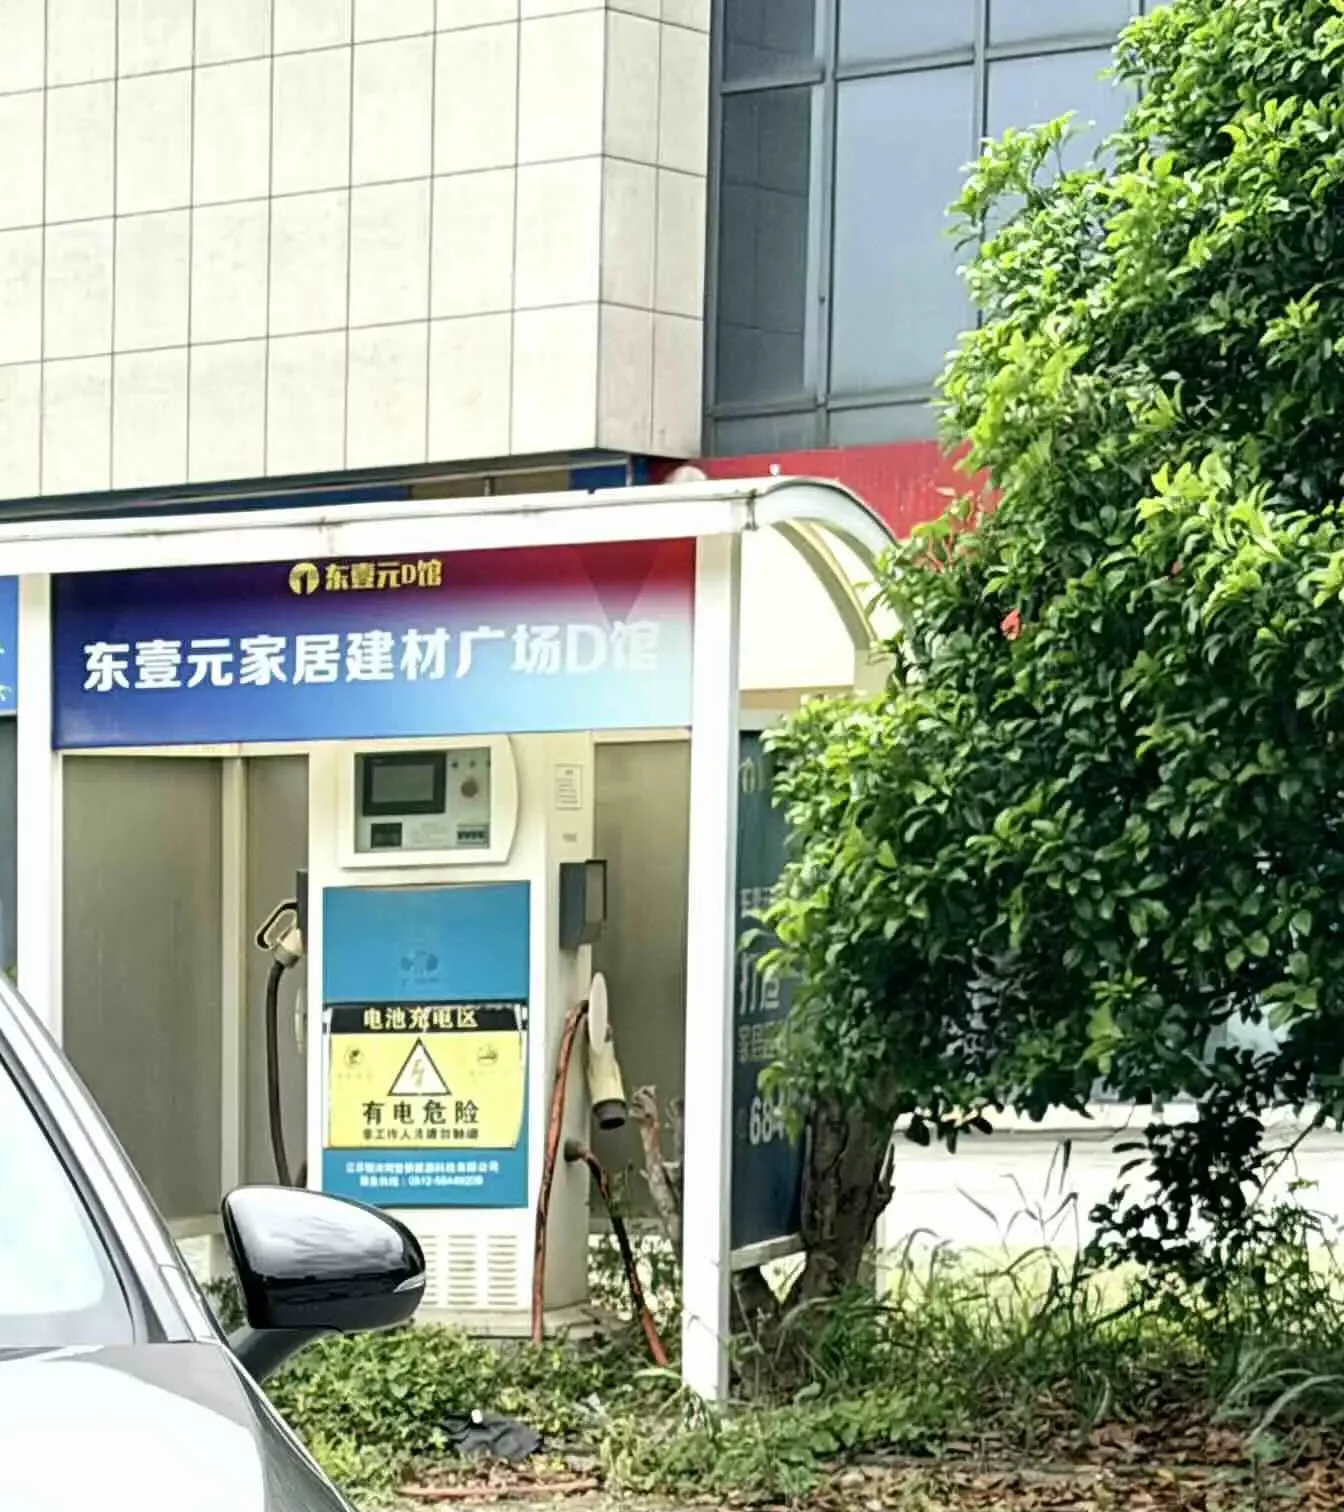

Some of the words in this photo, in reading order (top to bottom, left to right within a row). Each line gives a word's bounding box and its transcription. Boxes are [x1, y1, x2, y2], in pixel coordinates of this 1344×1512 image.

[325, 559, 443, 590] 东壹元D馆
[83, 620, 660, 692] 东壹元家居建材广场D馆
[363, 1006, 478, 1030] 电池充电区
[362, 1099, 480, 1126] 有电危险
